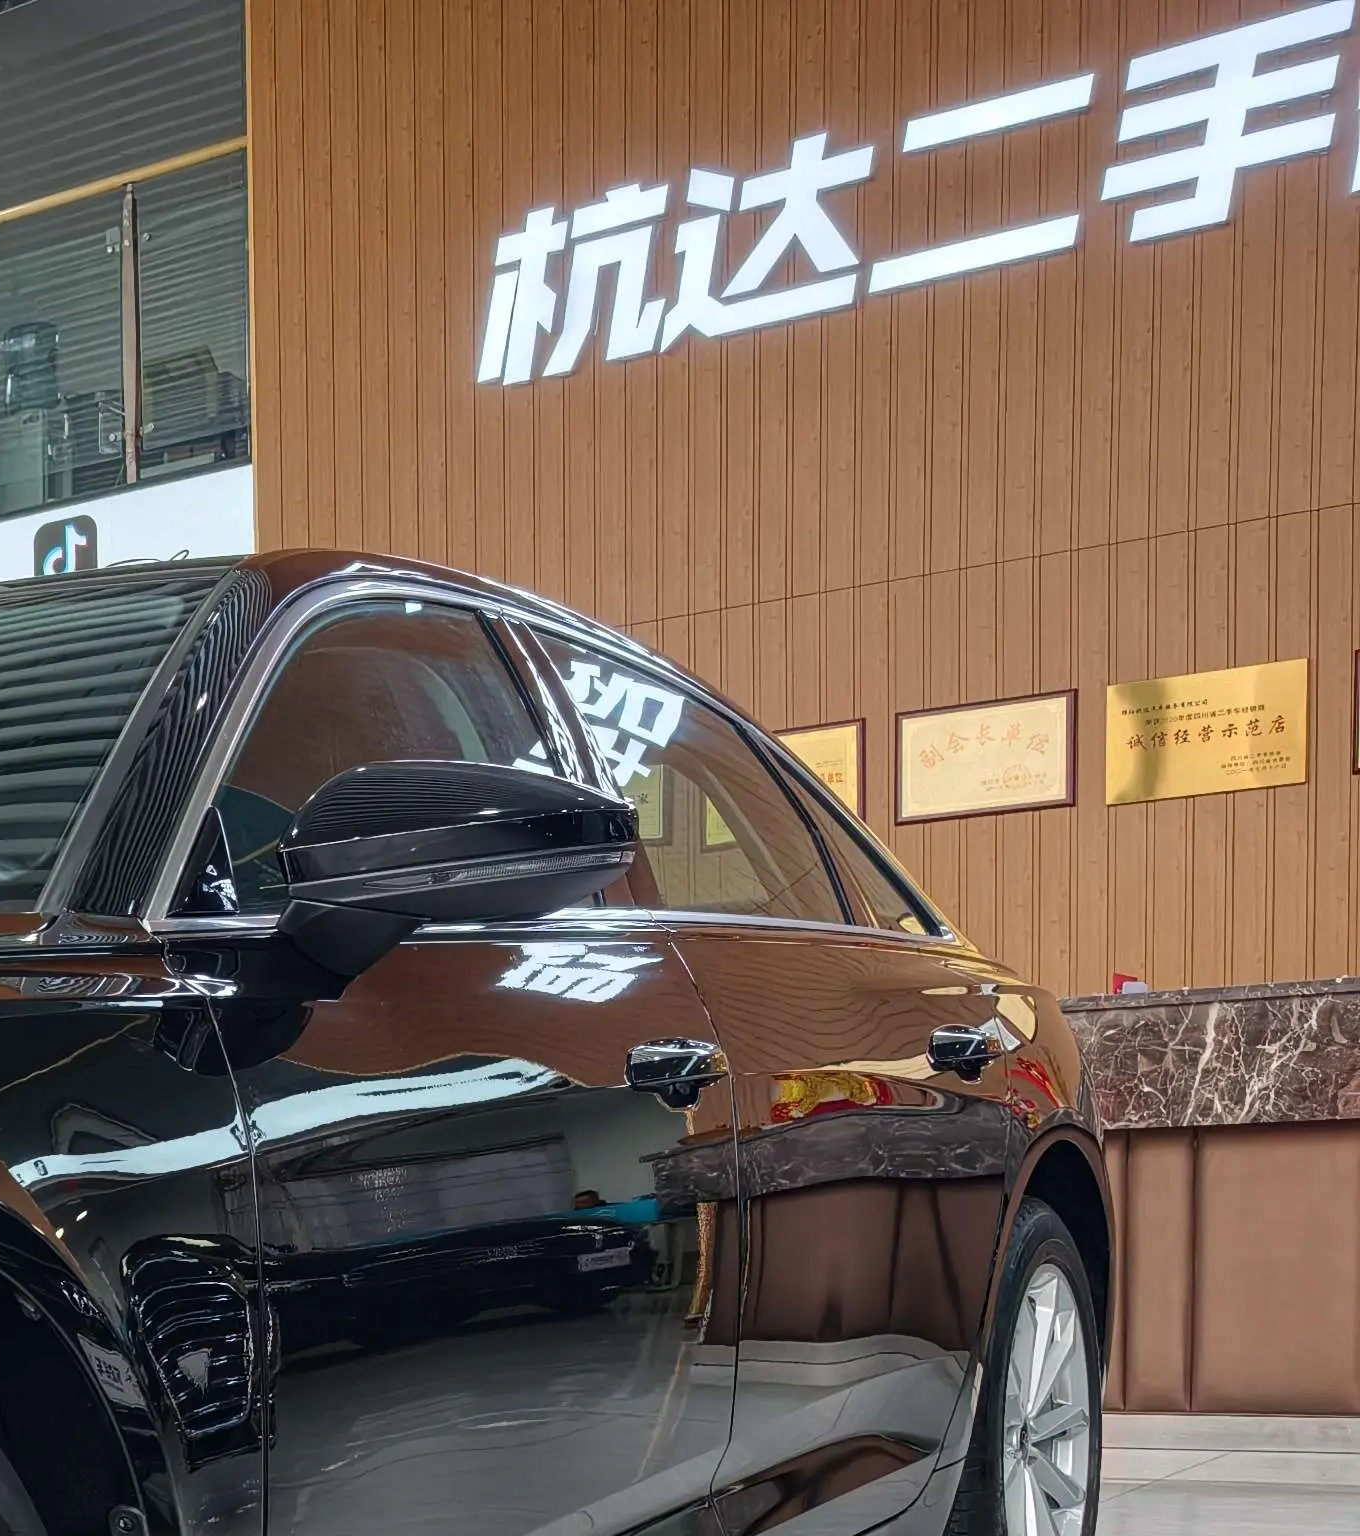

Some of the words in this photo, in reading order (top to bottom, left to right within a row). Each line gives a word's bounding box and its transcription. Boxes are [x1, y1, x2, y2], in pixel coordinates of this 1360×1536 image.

[477, 0, 1360, 387] 杭达二手
[1127, 714, 1288, 751] 诚信经营示范店
